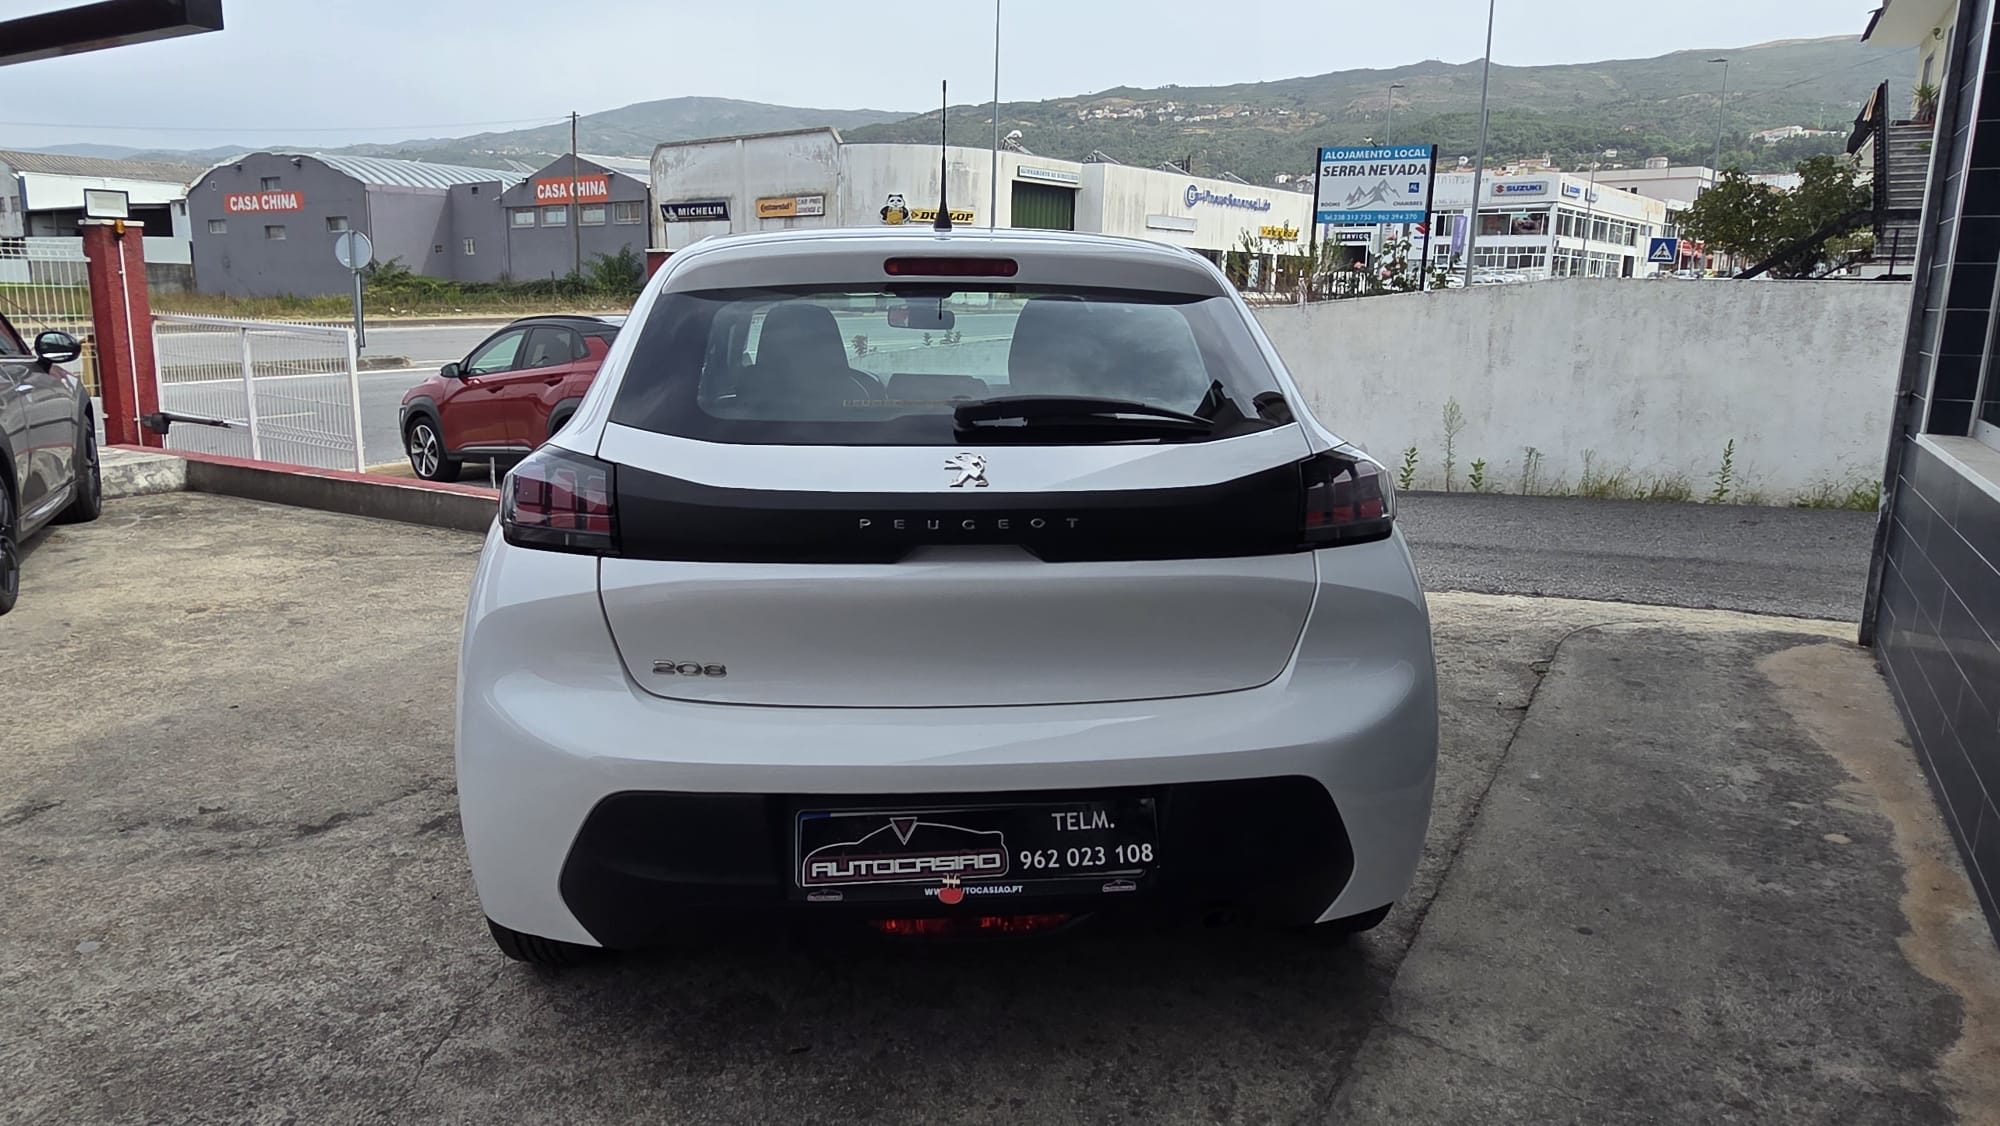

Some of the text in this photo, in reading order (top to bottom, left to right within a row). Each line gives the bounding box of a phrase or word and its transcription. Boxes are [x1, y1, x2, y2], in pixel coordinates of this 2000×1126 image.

[1325, 148, 1427, 160] ALOJAMENTO LOCAL
[1322, 163, 1427, 177] SERRA NEVADA
[537, 183, 567, 199] CASA
[1506, 184, 1542, 192] SUZUKI
[229, 193, 298, 211] CASA CHINA
[678, 206, 724, 216] MICHELIN
[920, 211, 974, 221] DULOP
[859, 517, 1079, 530] PEUGEOT
[653, 660, 727, 678] 208
[1051, 810, 1115, 831] TELM.
[1020, 843, 1153, 869] 962 023 108
